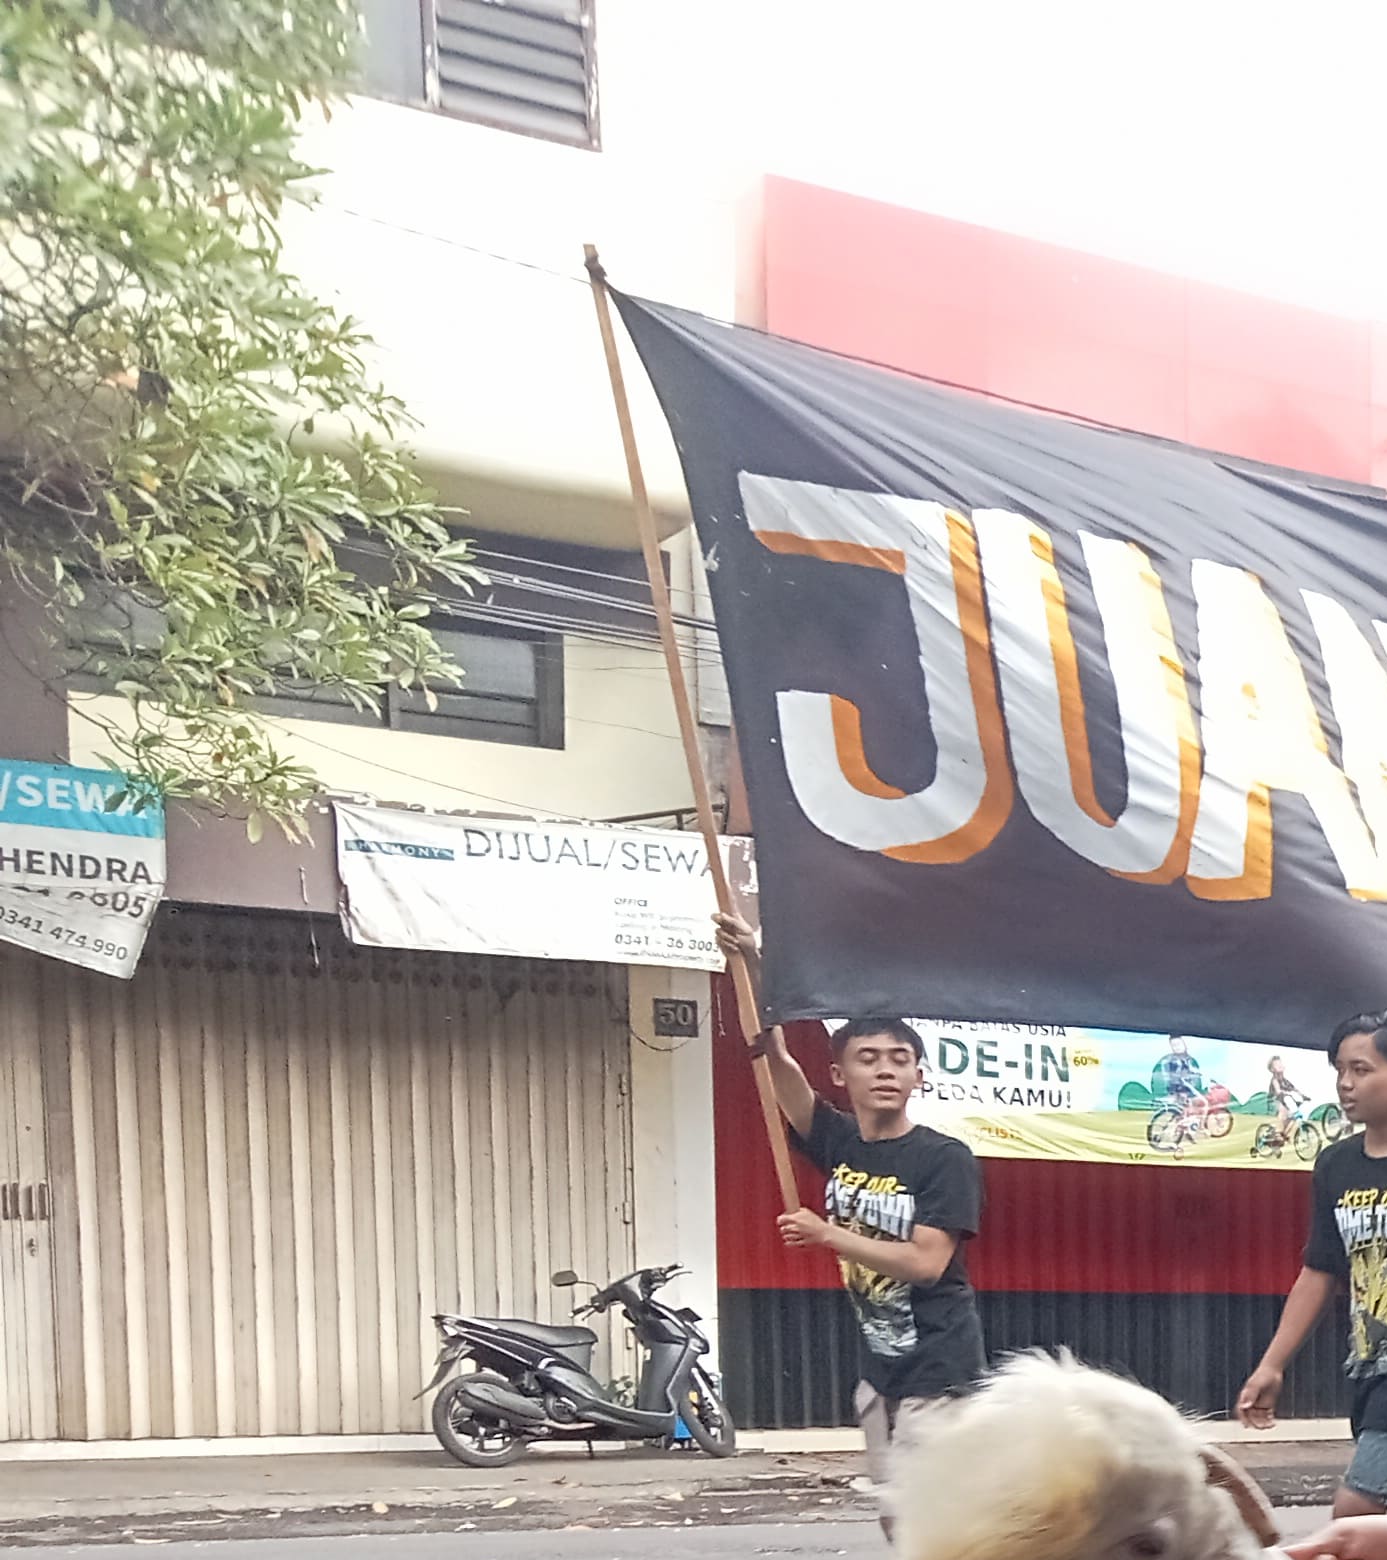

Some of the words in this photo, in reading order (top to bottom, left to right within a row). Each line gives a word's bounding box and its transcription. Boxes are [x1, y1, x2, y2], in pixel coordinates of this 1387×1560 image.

[658, 1004, 694, 1026] 50
[908, 1080, 984, 1104] PEDA
[993, 1086, 1072, 1109] KAMU!
